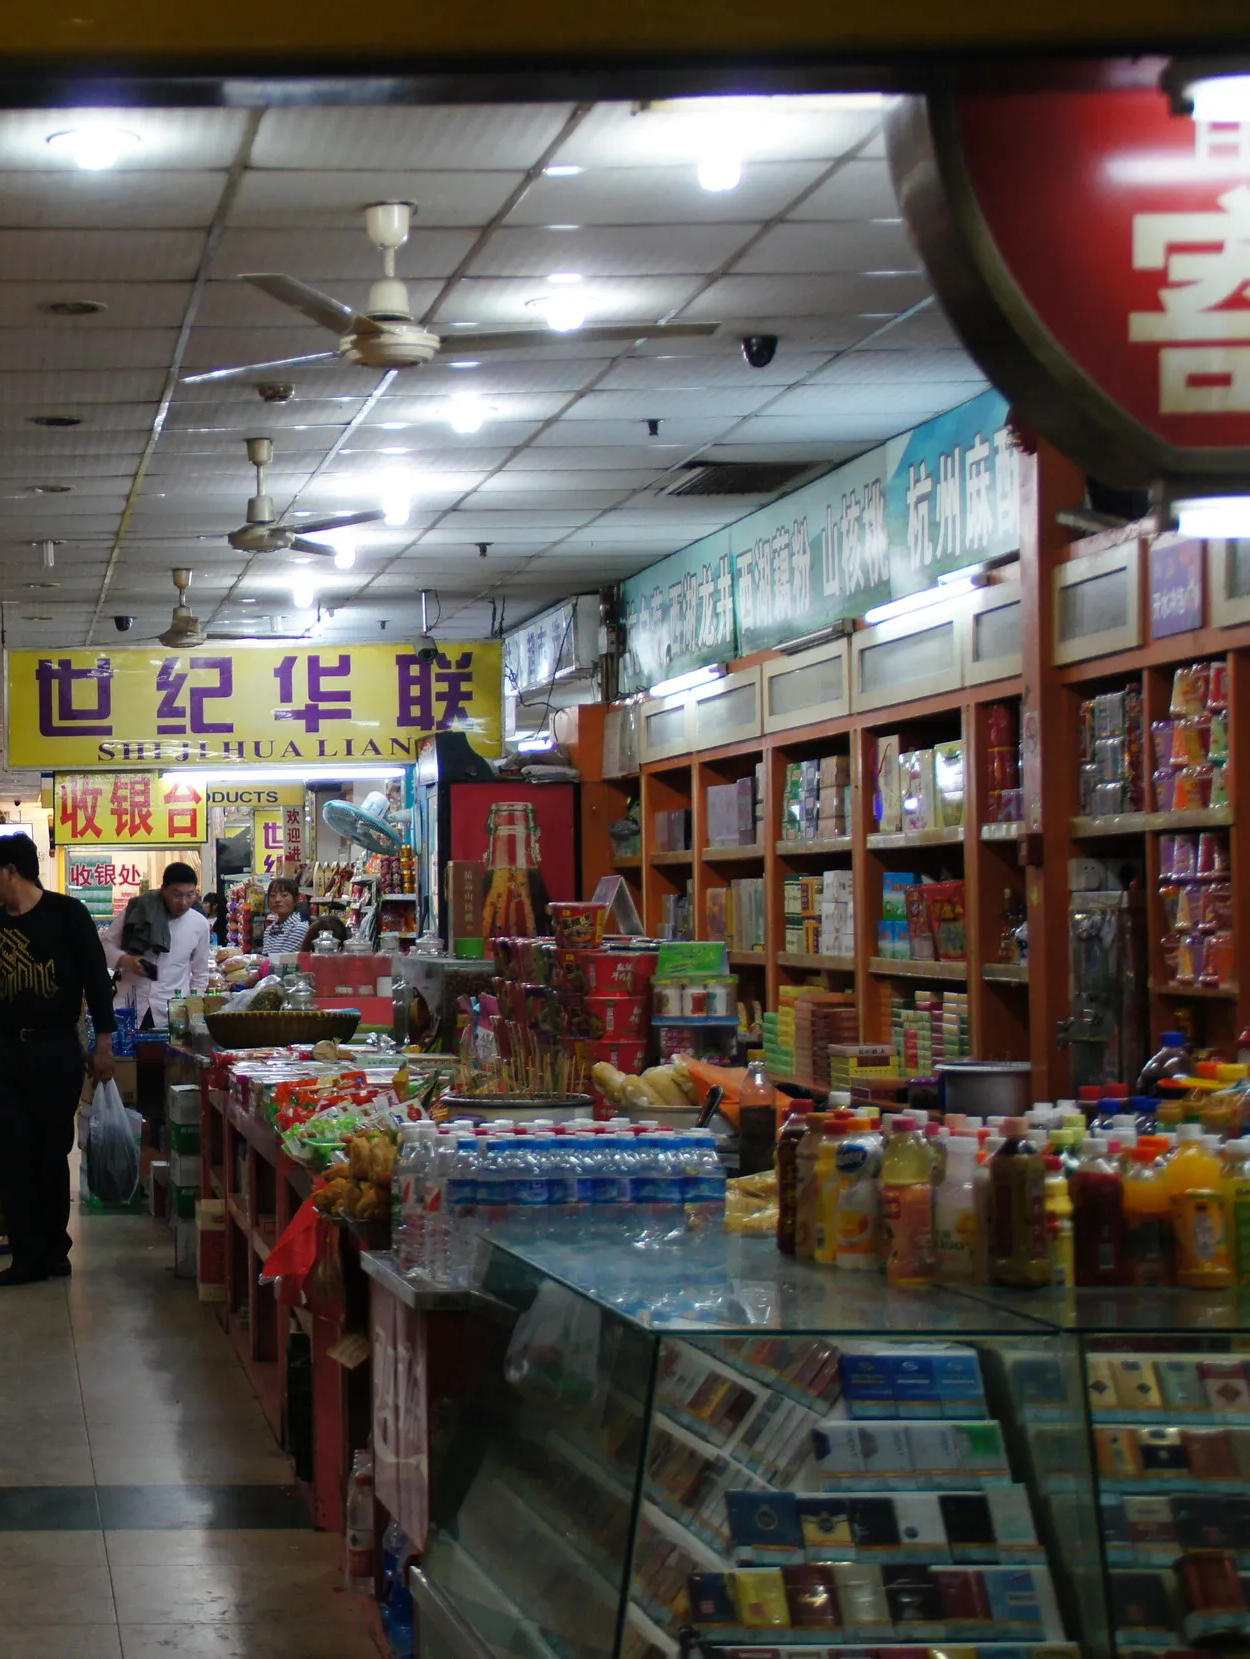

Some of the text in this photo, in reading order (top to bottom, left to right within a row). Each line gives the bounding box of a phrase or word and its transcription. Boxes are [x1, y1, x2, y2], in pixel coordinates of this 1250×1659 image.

[669, 553, 734, 659] 西湖龙井
[822, 477, 889, 597] 山核桃
[36, 652, 473, 737] 世纪华联
[98, 742, 161, 761] SHI
[222, 739, 304, 760] HUA
[317, 737, 413, 757] LIAN
[60, 775, 202, 839] 收银台
[206, 790, 279, 804] DUCTS
[70, 863, 141, 887] 收银处
